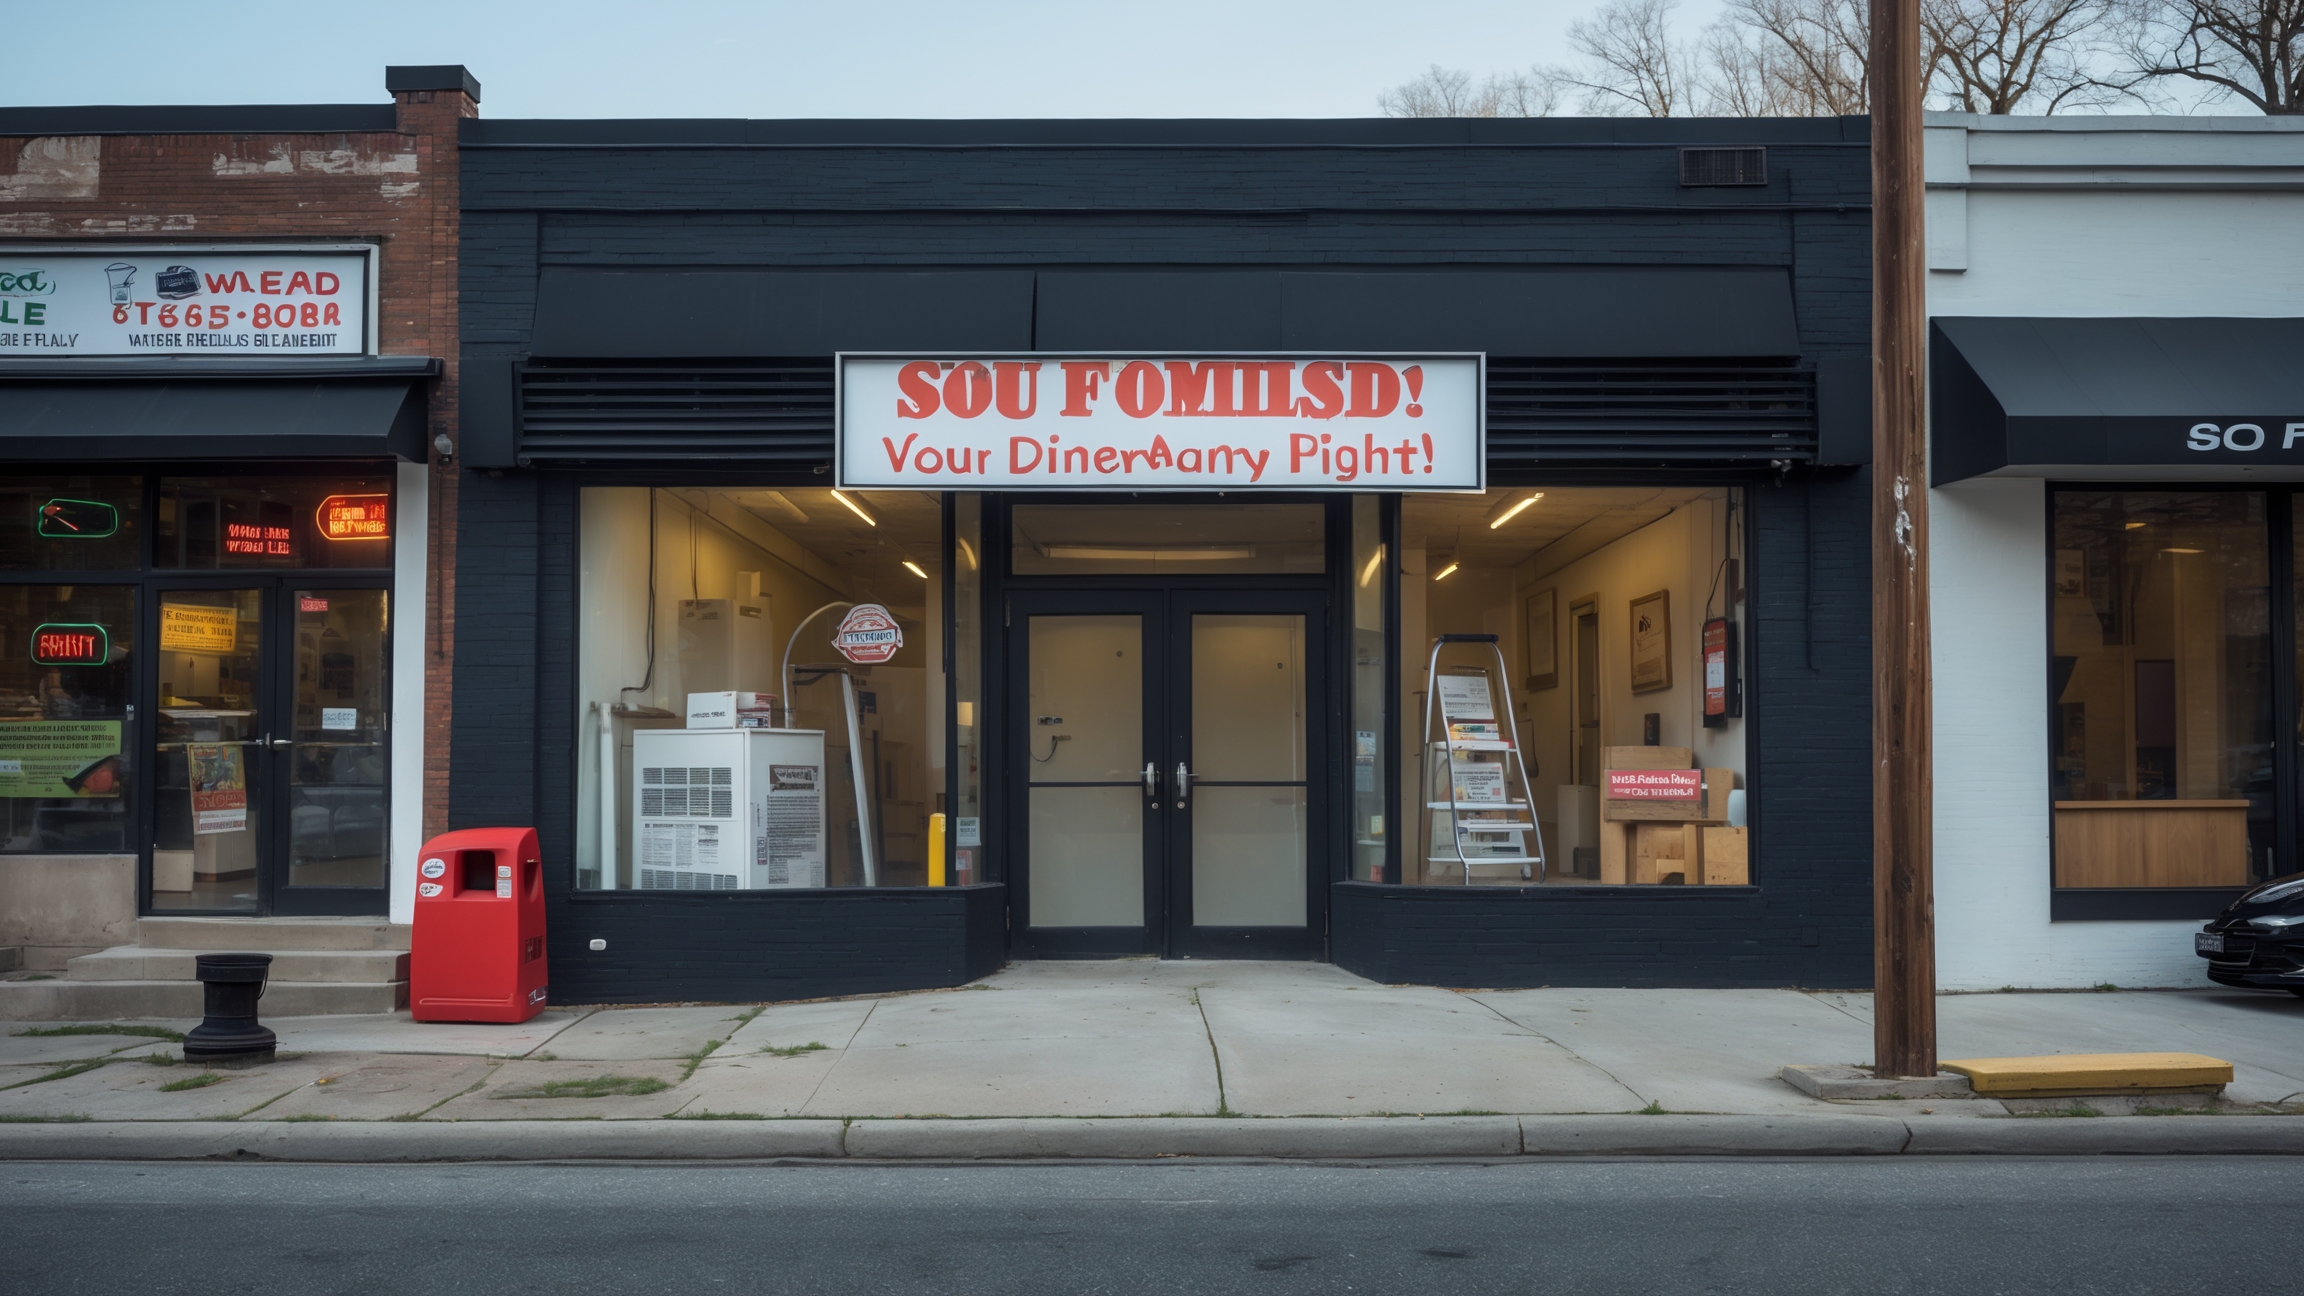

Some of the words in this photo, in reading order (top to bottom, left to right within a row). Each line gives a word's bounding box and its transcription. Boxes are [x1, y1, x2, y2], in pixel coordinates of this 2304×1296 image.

[896, 360, 1043, 420] SOU
[1289, 432, 1434, 482] Pight!
[2186, 422, 2265, 451] SO
